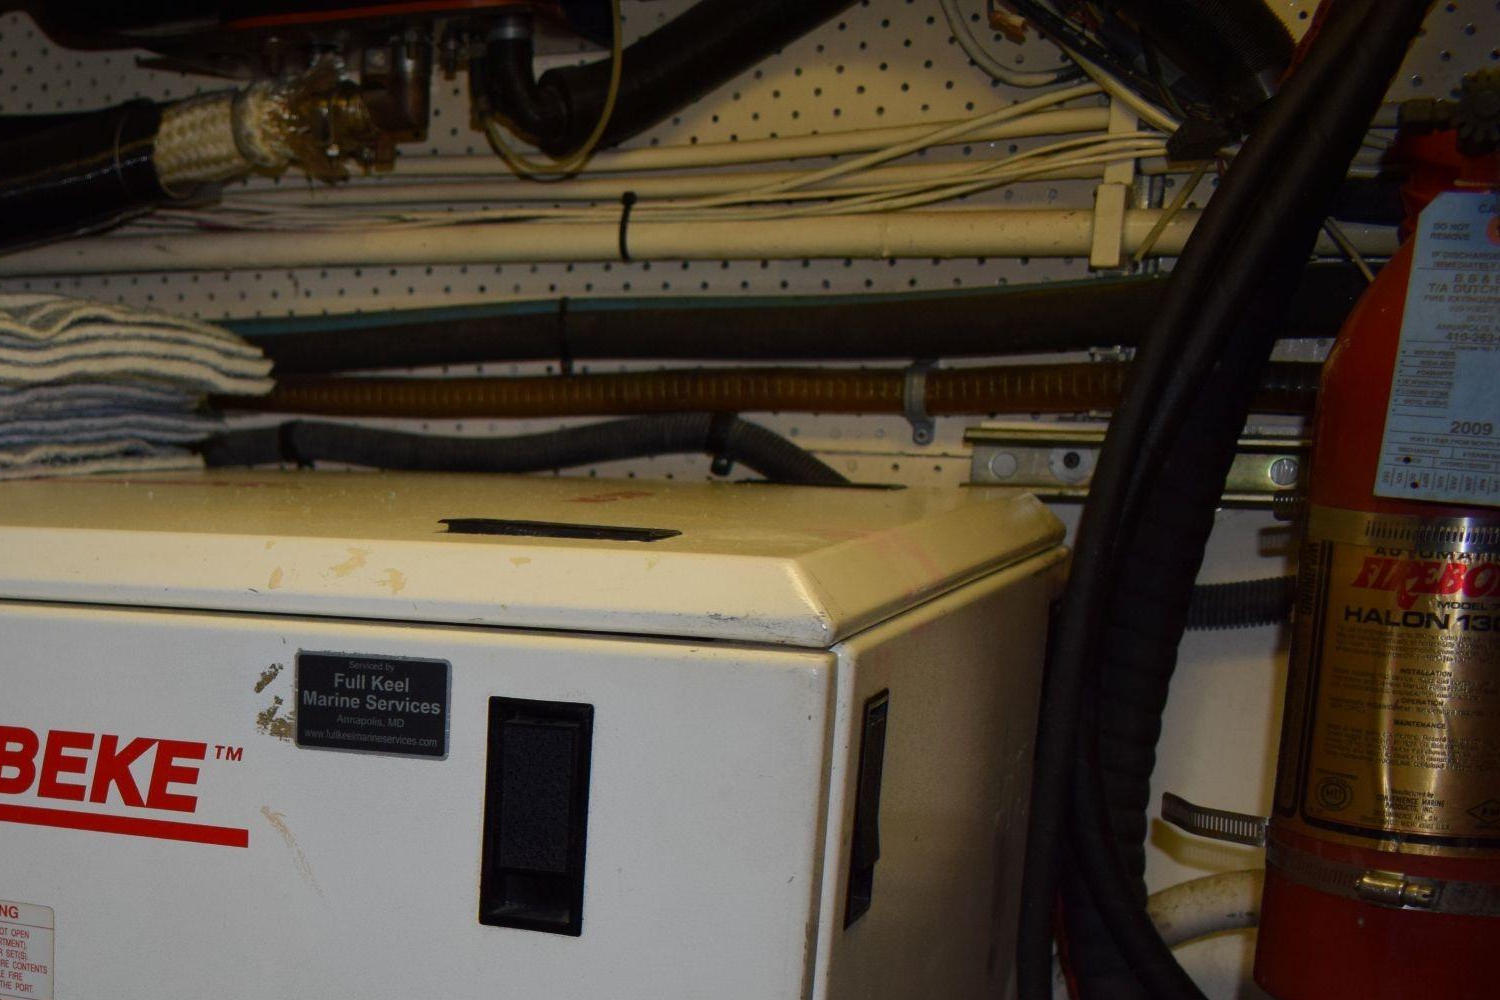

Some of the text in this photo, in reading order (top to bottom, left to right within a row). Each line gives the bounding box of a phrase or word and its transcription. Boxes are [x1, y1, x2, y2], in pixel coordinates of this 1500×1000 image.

[1450, 421, 1493, 436] 2009
[1344, 605, 1450, 630] HALON
[385, 663, 395, 672] by
[1400, 668, 1453, 677] INSTALLATION
[334, 673, 409, 692] Full Keel
[303, 690, 441, 715] Marine Services
[388, 718, 404, 728] MD
[1393, 718, 1446, 730] MAINTENANCE
[11, 929, 30, 938] OPEN
[13, 959, 48, 975] CONTENTS
[9, 971, 23, 981] FIRE
[0, 980, 12, 989] THE
